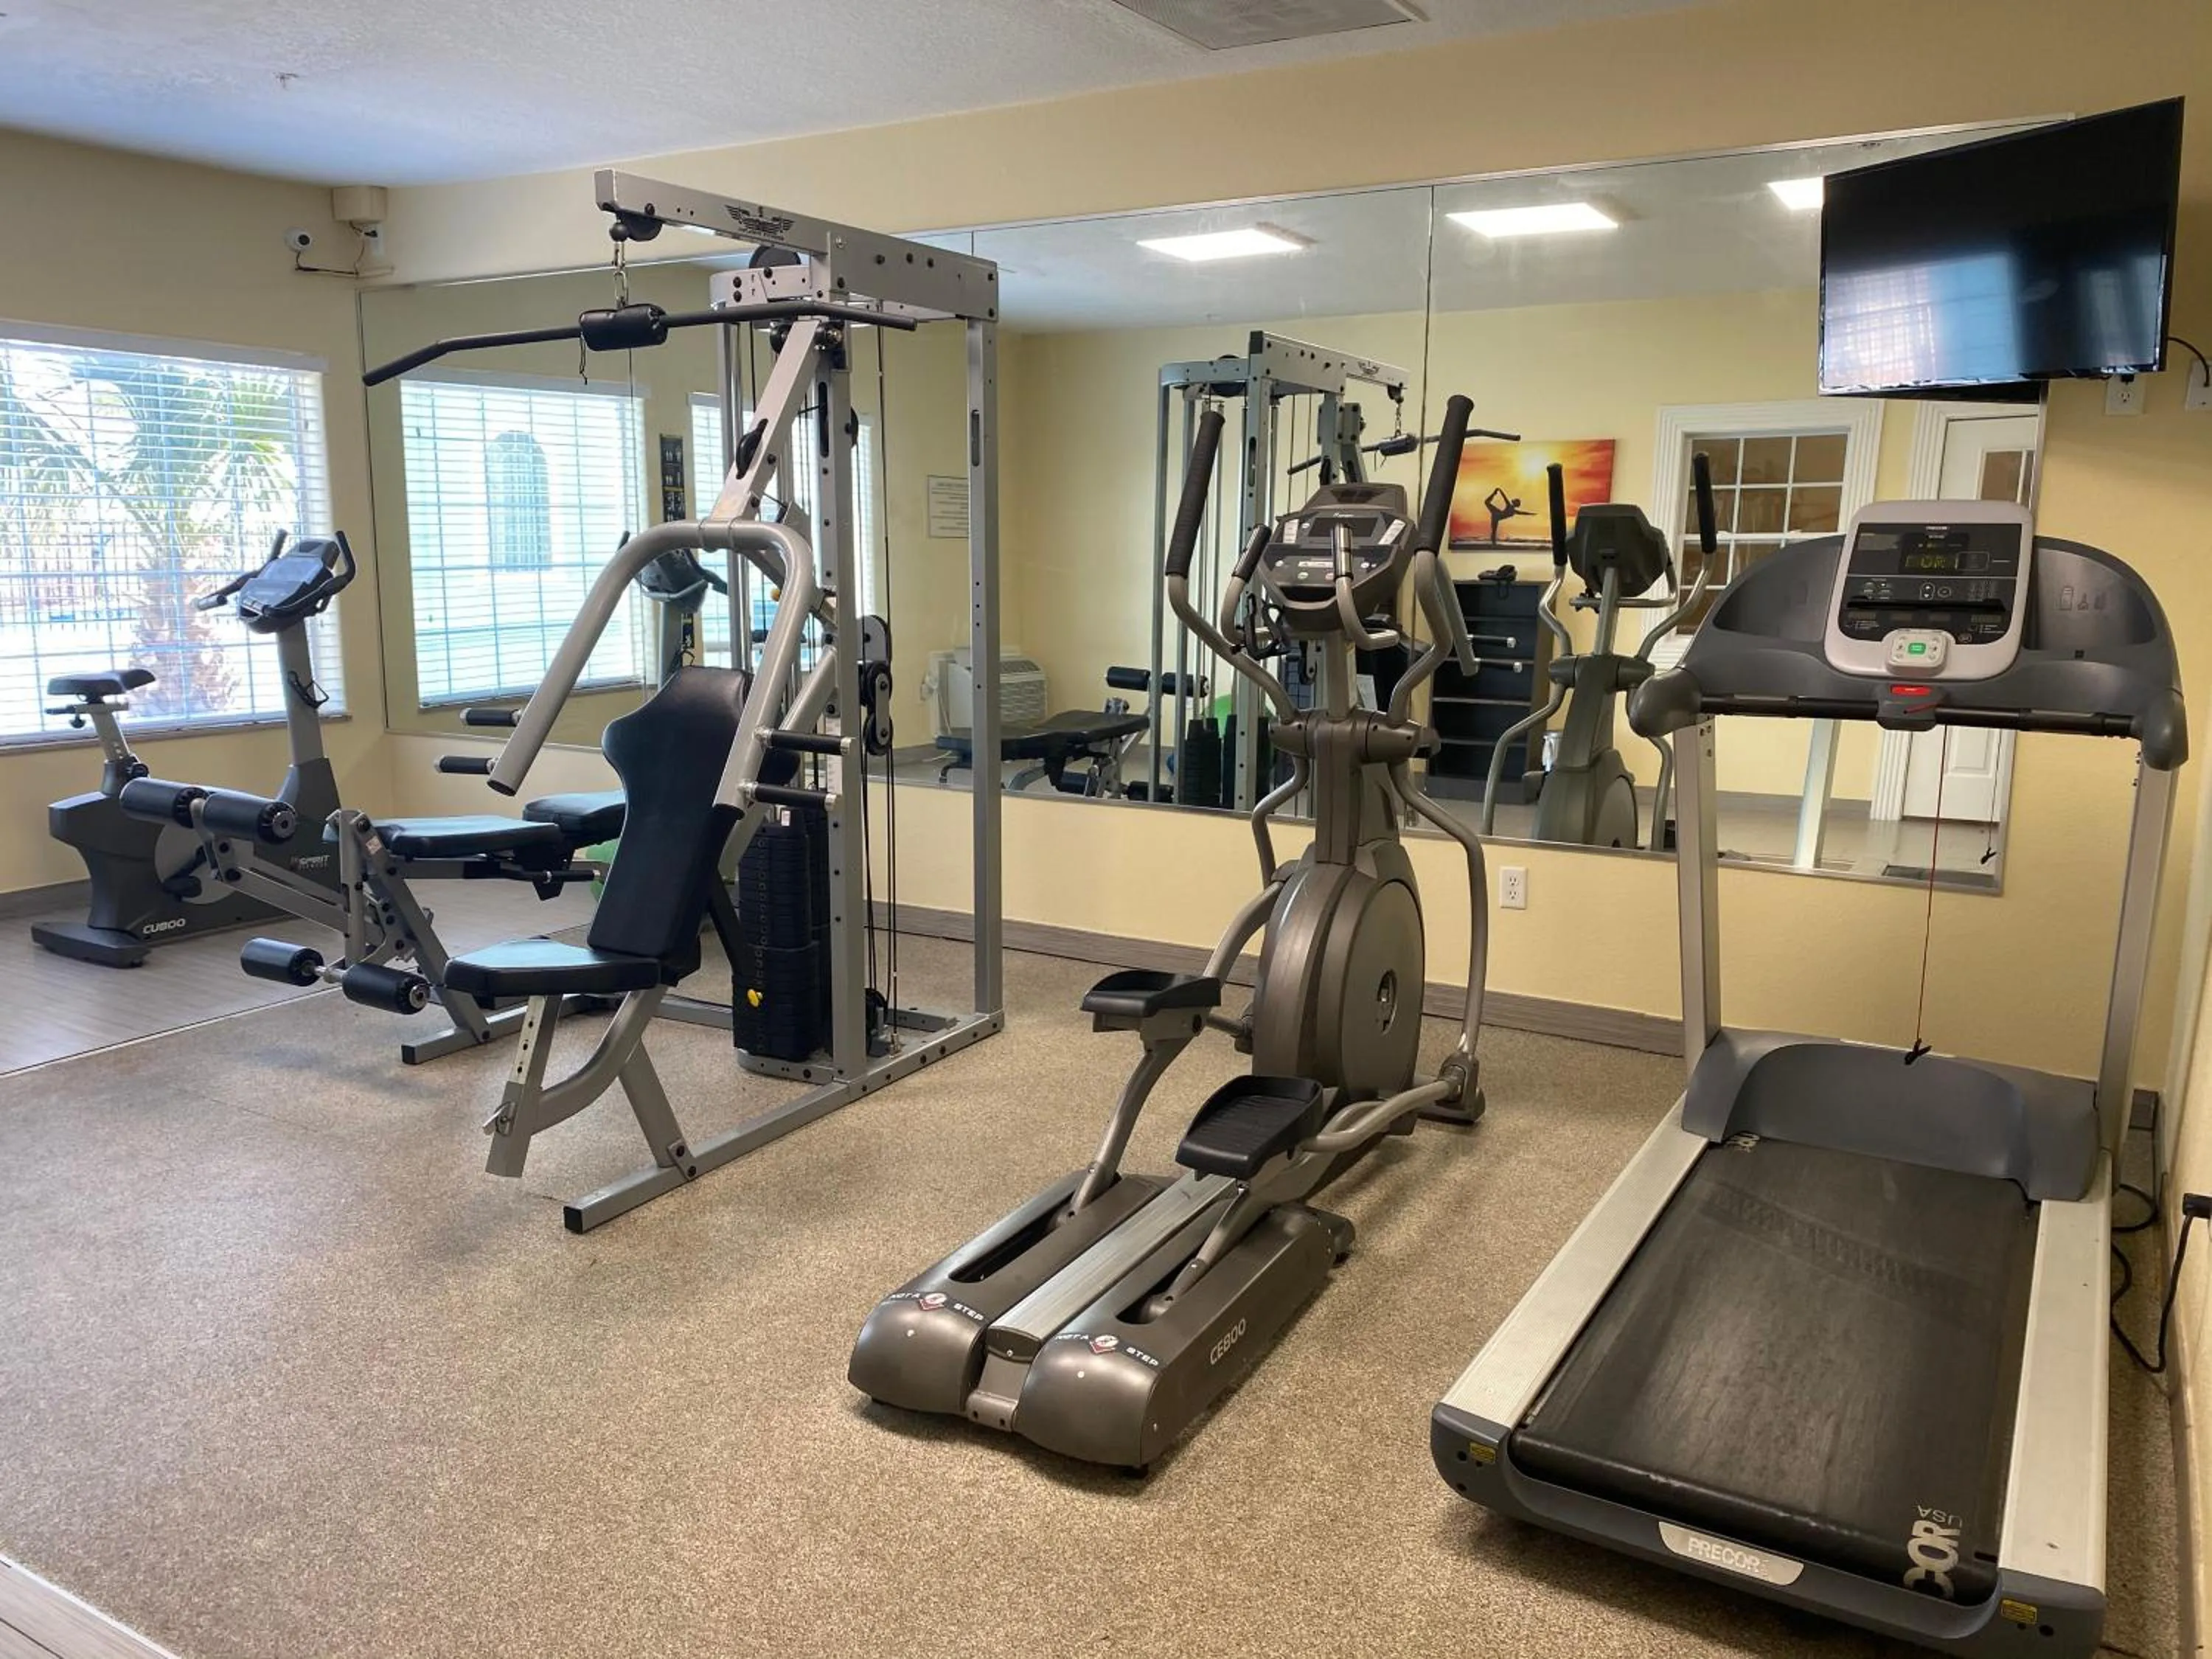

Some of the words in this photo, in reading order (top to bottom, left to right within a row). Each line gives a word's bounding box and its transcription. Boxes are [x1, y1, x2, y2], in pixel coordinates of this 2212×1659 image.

[953, 1303, 984, 1321] STEP
[1126, 1346, 1159, 1366] STEP
[1917, 1504, 1963, 1528] USA
